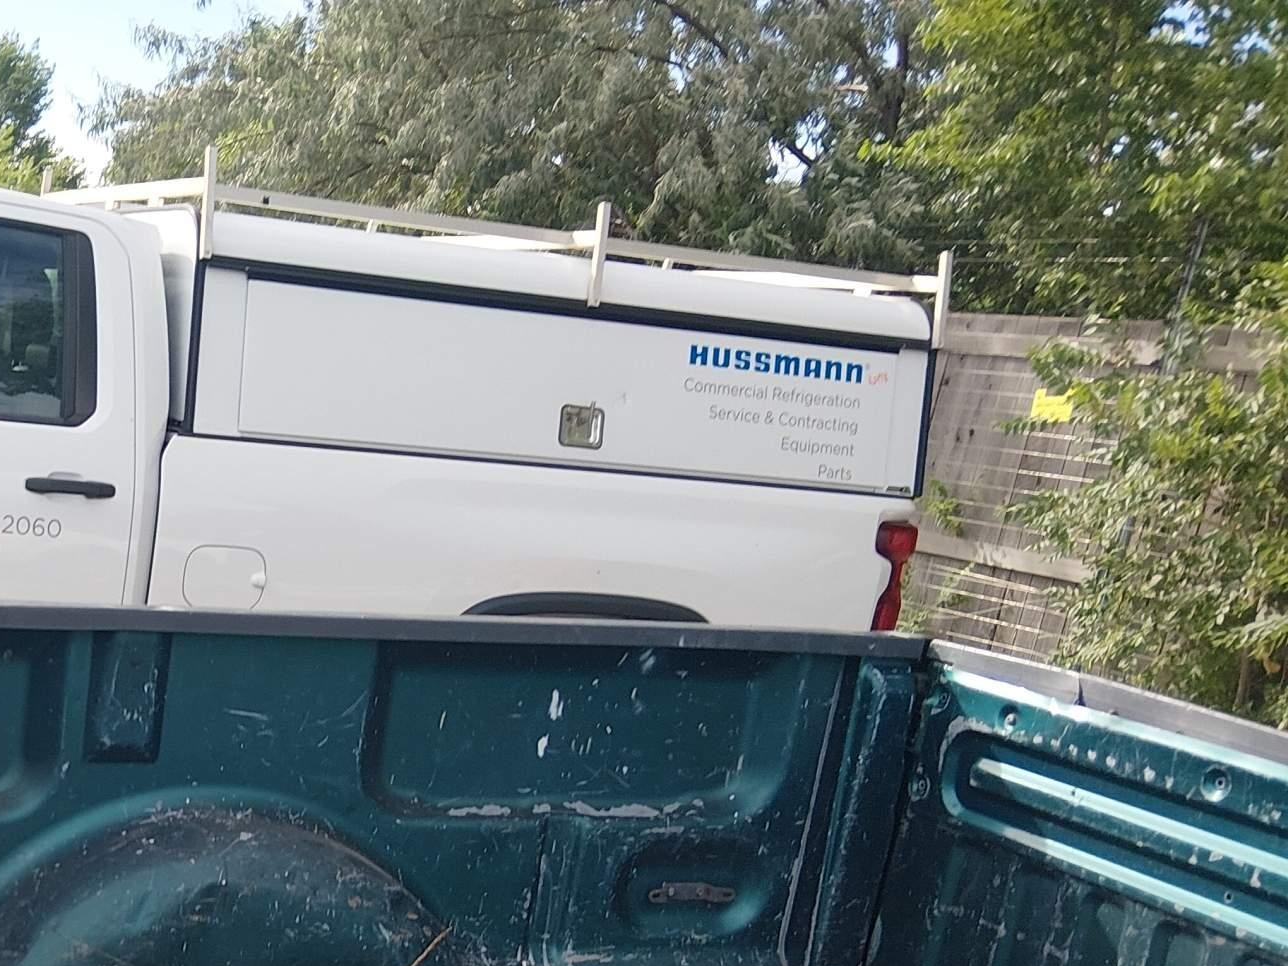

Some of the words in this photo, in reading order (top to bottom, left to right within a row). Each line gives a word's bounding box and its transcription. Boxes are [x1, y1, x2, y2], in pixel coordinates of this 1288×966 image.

[683, 377, 768, 401] Commercial
[772, 386, 861, 410] Refrigeration
[709, 405, 760, 424] Service
[764, 410, 774, 424] &
[778, 412, 858, 435] Contracting
[781, 437, 855, 457] Equipment
[817, 464, 852, 481] Parts
